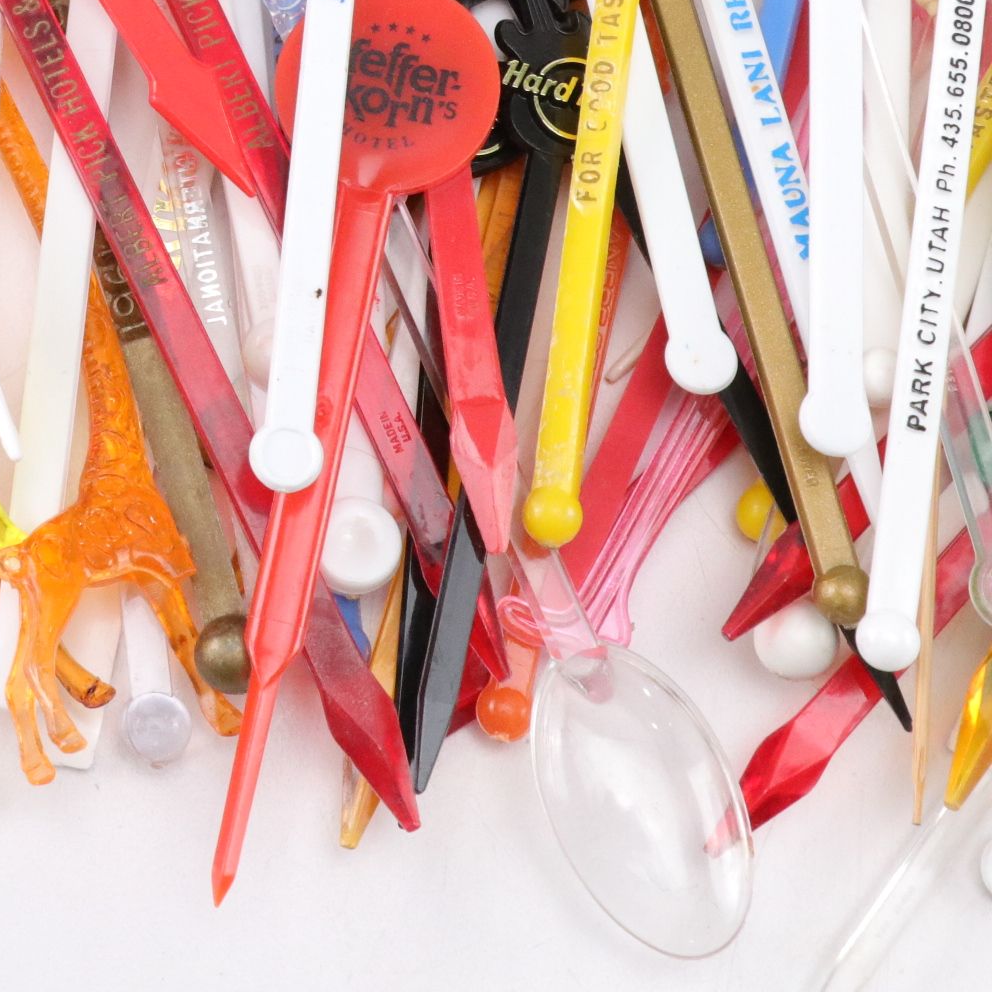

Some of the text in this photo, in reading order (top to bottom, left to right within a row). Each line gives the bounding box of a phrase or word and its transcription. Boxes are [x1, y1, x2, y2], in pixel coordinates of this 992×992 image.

[24, 18, 87, 118] HOTELS
[214, 57, 274, 150] ALBERT
[502, 59, 579, 103] Hard
[743, 49, 783, 127] LANI
[71, 121, 119, 183] PICK
[574, 150, 603, 204] FOR
[770, 142, 810, 261] MAUNA
[907, 362, 935, 433] PARK
[935, 156, 957, 193] Ph.
